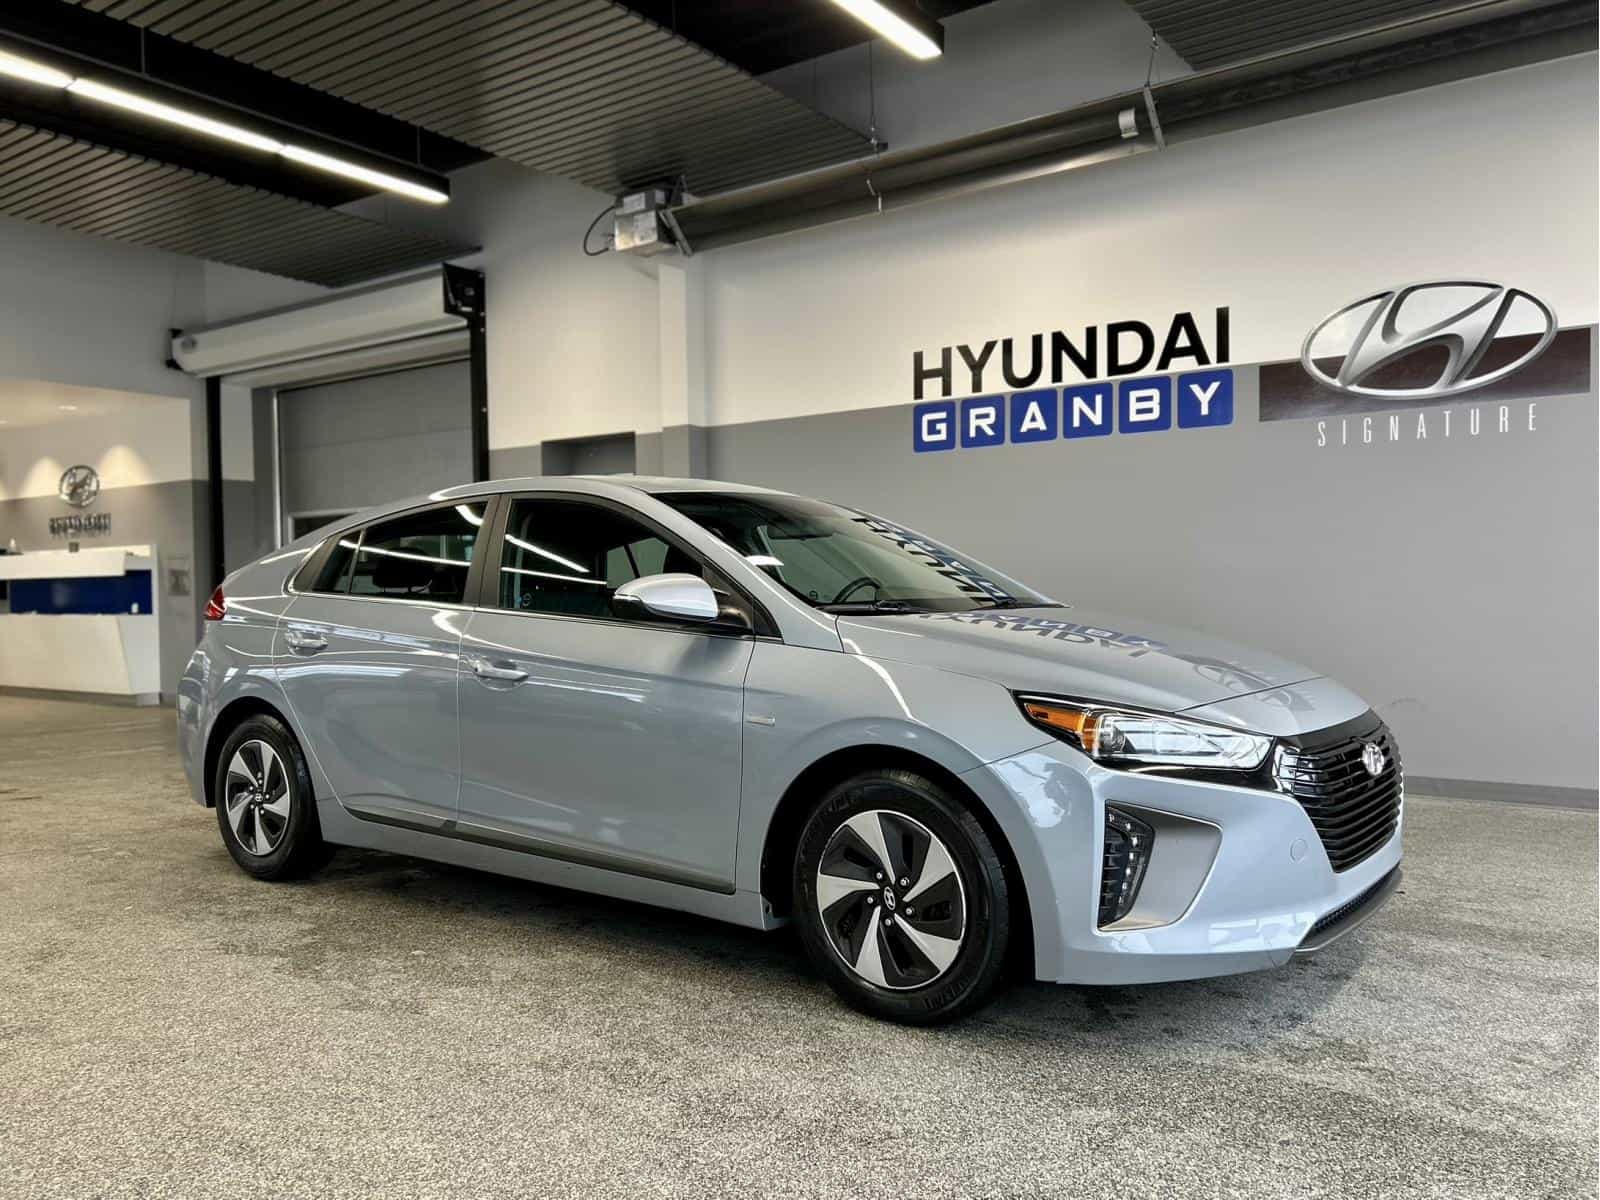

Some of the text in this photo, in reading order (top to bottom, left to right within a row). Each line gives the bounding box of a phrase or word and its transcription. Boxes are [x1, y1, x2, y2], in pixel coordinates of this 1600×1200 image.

[912, 306, 1230, 400] HYUNDAI
[921, 380, 1222, 443] GRANBY
[1317, 402, 1538, 448] SIGNATURE
